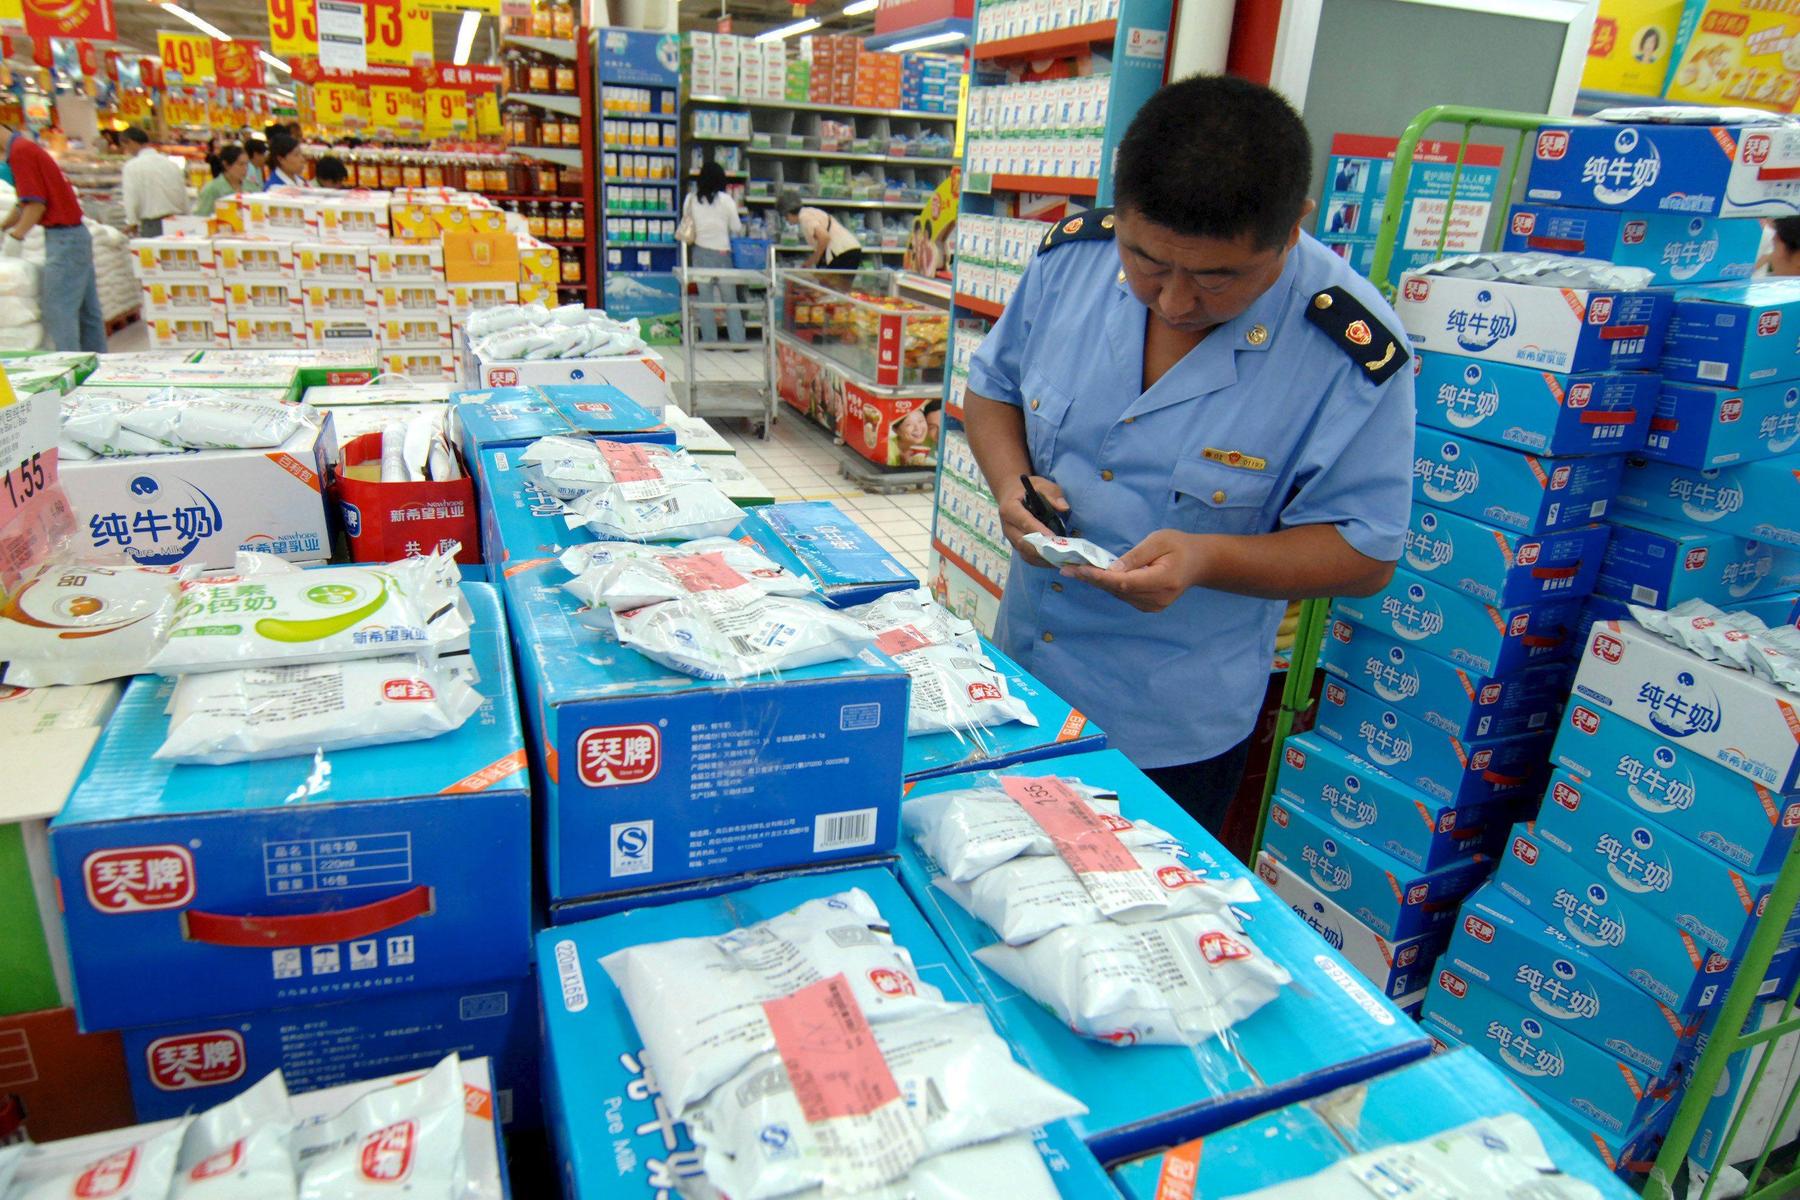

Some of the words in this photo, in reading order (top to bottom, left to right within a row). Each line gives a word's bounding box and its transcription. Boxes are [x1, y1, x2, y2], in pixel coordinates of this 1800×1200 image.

[164, 39, 195, 75] 49
[330, 89, 342, 113] 5
[386, 92, 397, 115] 5
[441, 95, 452, 118] 9
[1581, 155, 1661, 188] 纯牛奶
[1663, 239, 1718, 265] 纯牛奶
[1446, 309, 1511, 339] 纯牛奶
[1436, 383, 1498, 416] 纯牛奶
[4, 452, 45, 508] 1.55
[277, 456, 313, 483] 百利包
[1413, 457, 1478, 494] 纯牛奶
[1669, 478, 1741, 512] 纯牛奶
[90, 506, 214, 548] 纯牛奶
[390, 506, 465, 522] 新希望乳业
[128, 546, 155, 556] Pure
[160, 546, 184, 556] Milk
[239, 538, 321, 554] 新希望乳业
[1721, 557, 1773, 585] 纯牛奶
[1381, 597, 1443, 635] 纯牛奶
[1593, 633, 1624, 664] 琴牌
[1364, 657, 1419, 697] 纯牛奶
[1637, 682, 1714, 733] 纯牛奶
[586, 735, 652, 783] 琴牌
[1358, 721, 1412, 762] 纯牛奶
[1023, 783, 1059, 807] 1.55
[1616, 755, 1695, 809] 纯牛奶
[1321, 784, 1377, 824] 纯牛奶
[274, 846, 303, 857] 品名
[319, 841, 358, 853] 纯牛奶
[319, 857, 356, 870] 220ml
[1596, 833, 1672, 892] 纯牛奶
[95, 856, 186, 908] 琴牌
[321, 875, 349, 887] 16包
[1302, 845, 1351, 890] 纯牛奶
[1553, 889, 1627, 947] 纯牛奶
[1515, 965, 1600, 1019] 纯牛奶
[155, 1041, 238, 1084] 琴牌
[1486, 1021, 1563, 1077] 纯牛奶
[603, 1096, 625, 1136] Pure
[612, 1138, 638, 1177] Milk
